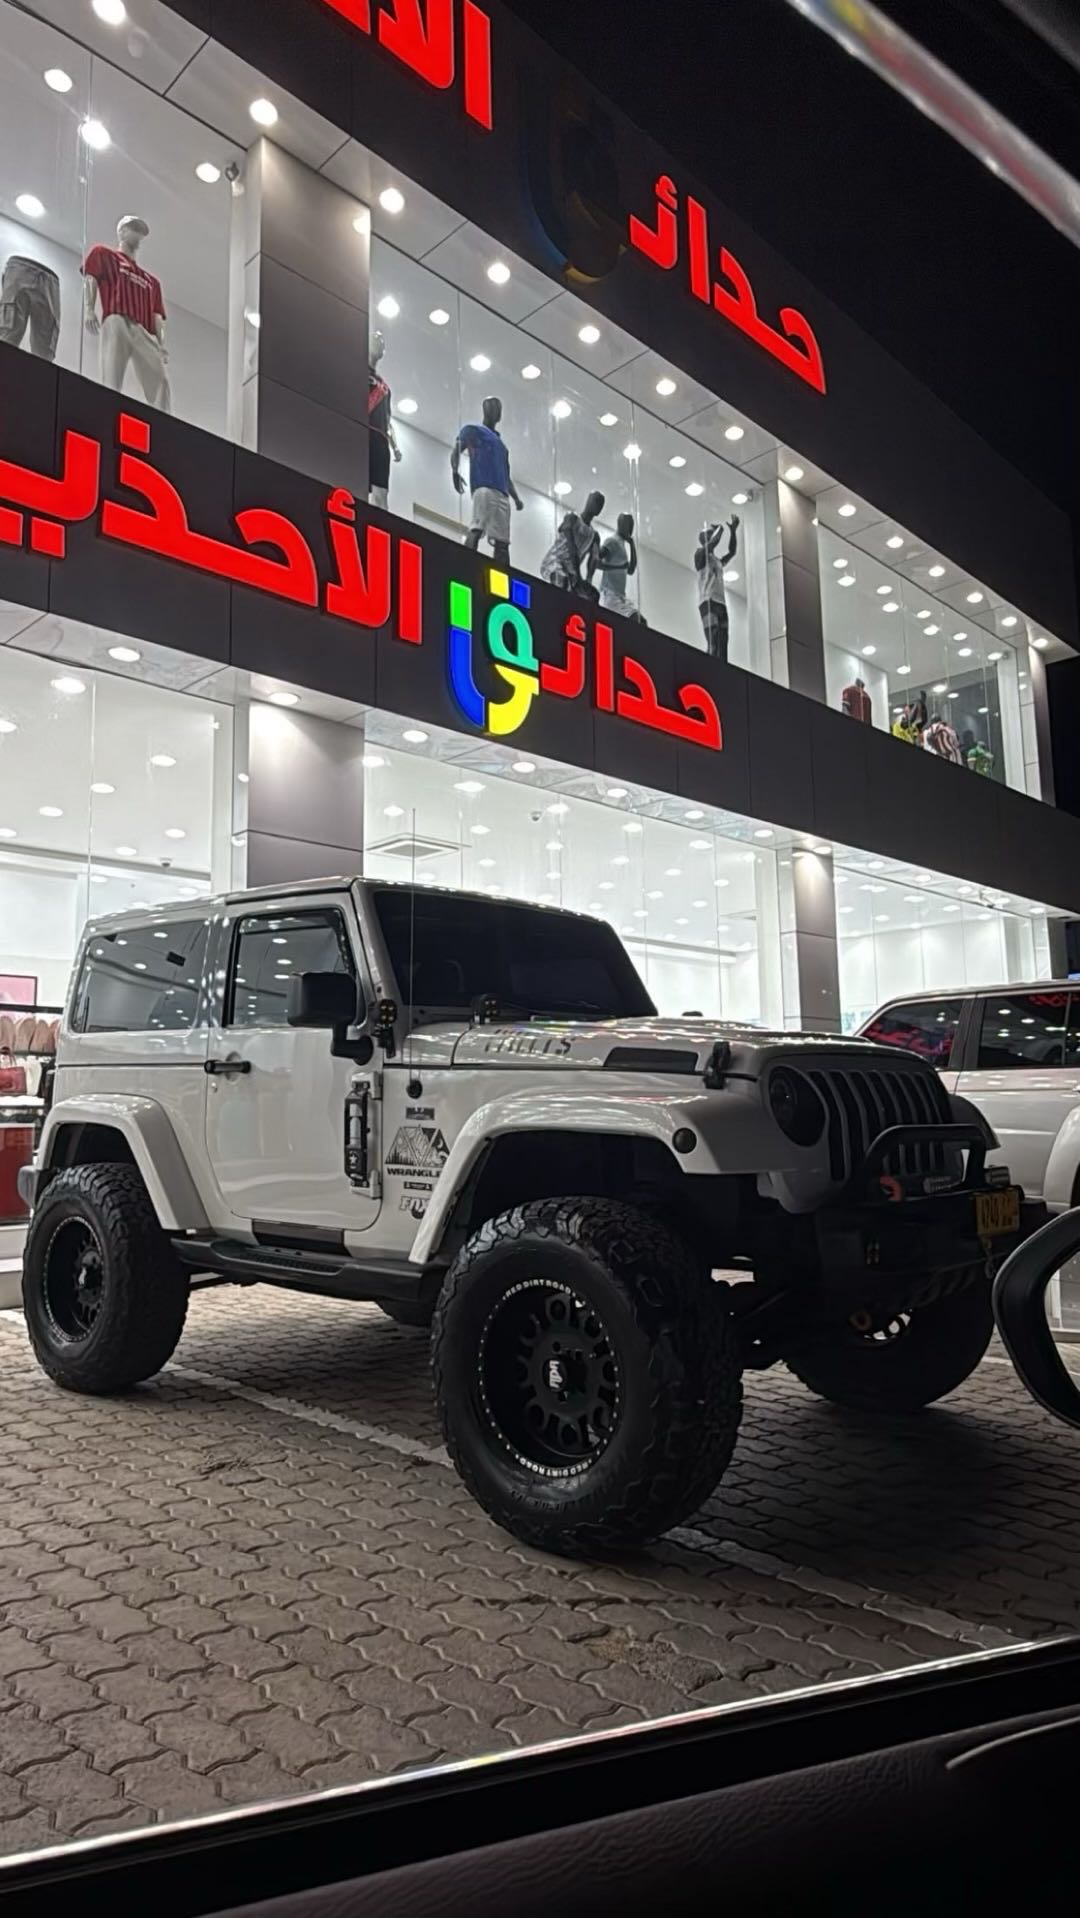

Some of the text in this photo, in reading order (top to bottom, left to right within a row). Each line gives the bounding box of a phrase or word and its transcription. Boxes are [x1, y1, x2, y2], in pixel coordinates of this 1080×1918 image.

[0, 413, 724, 751] حدائق الأحذي
[386, 1167, 441, 1178] WRANGLE
